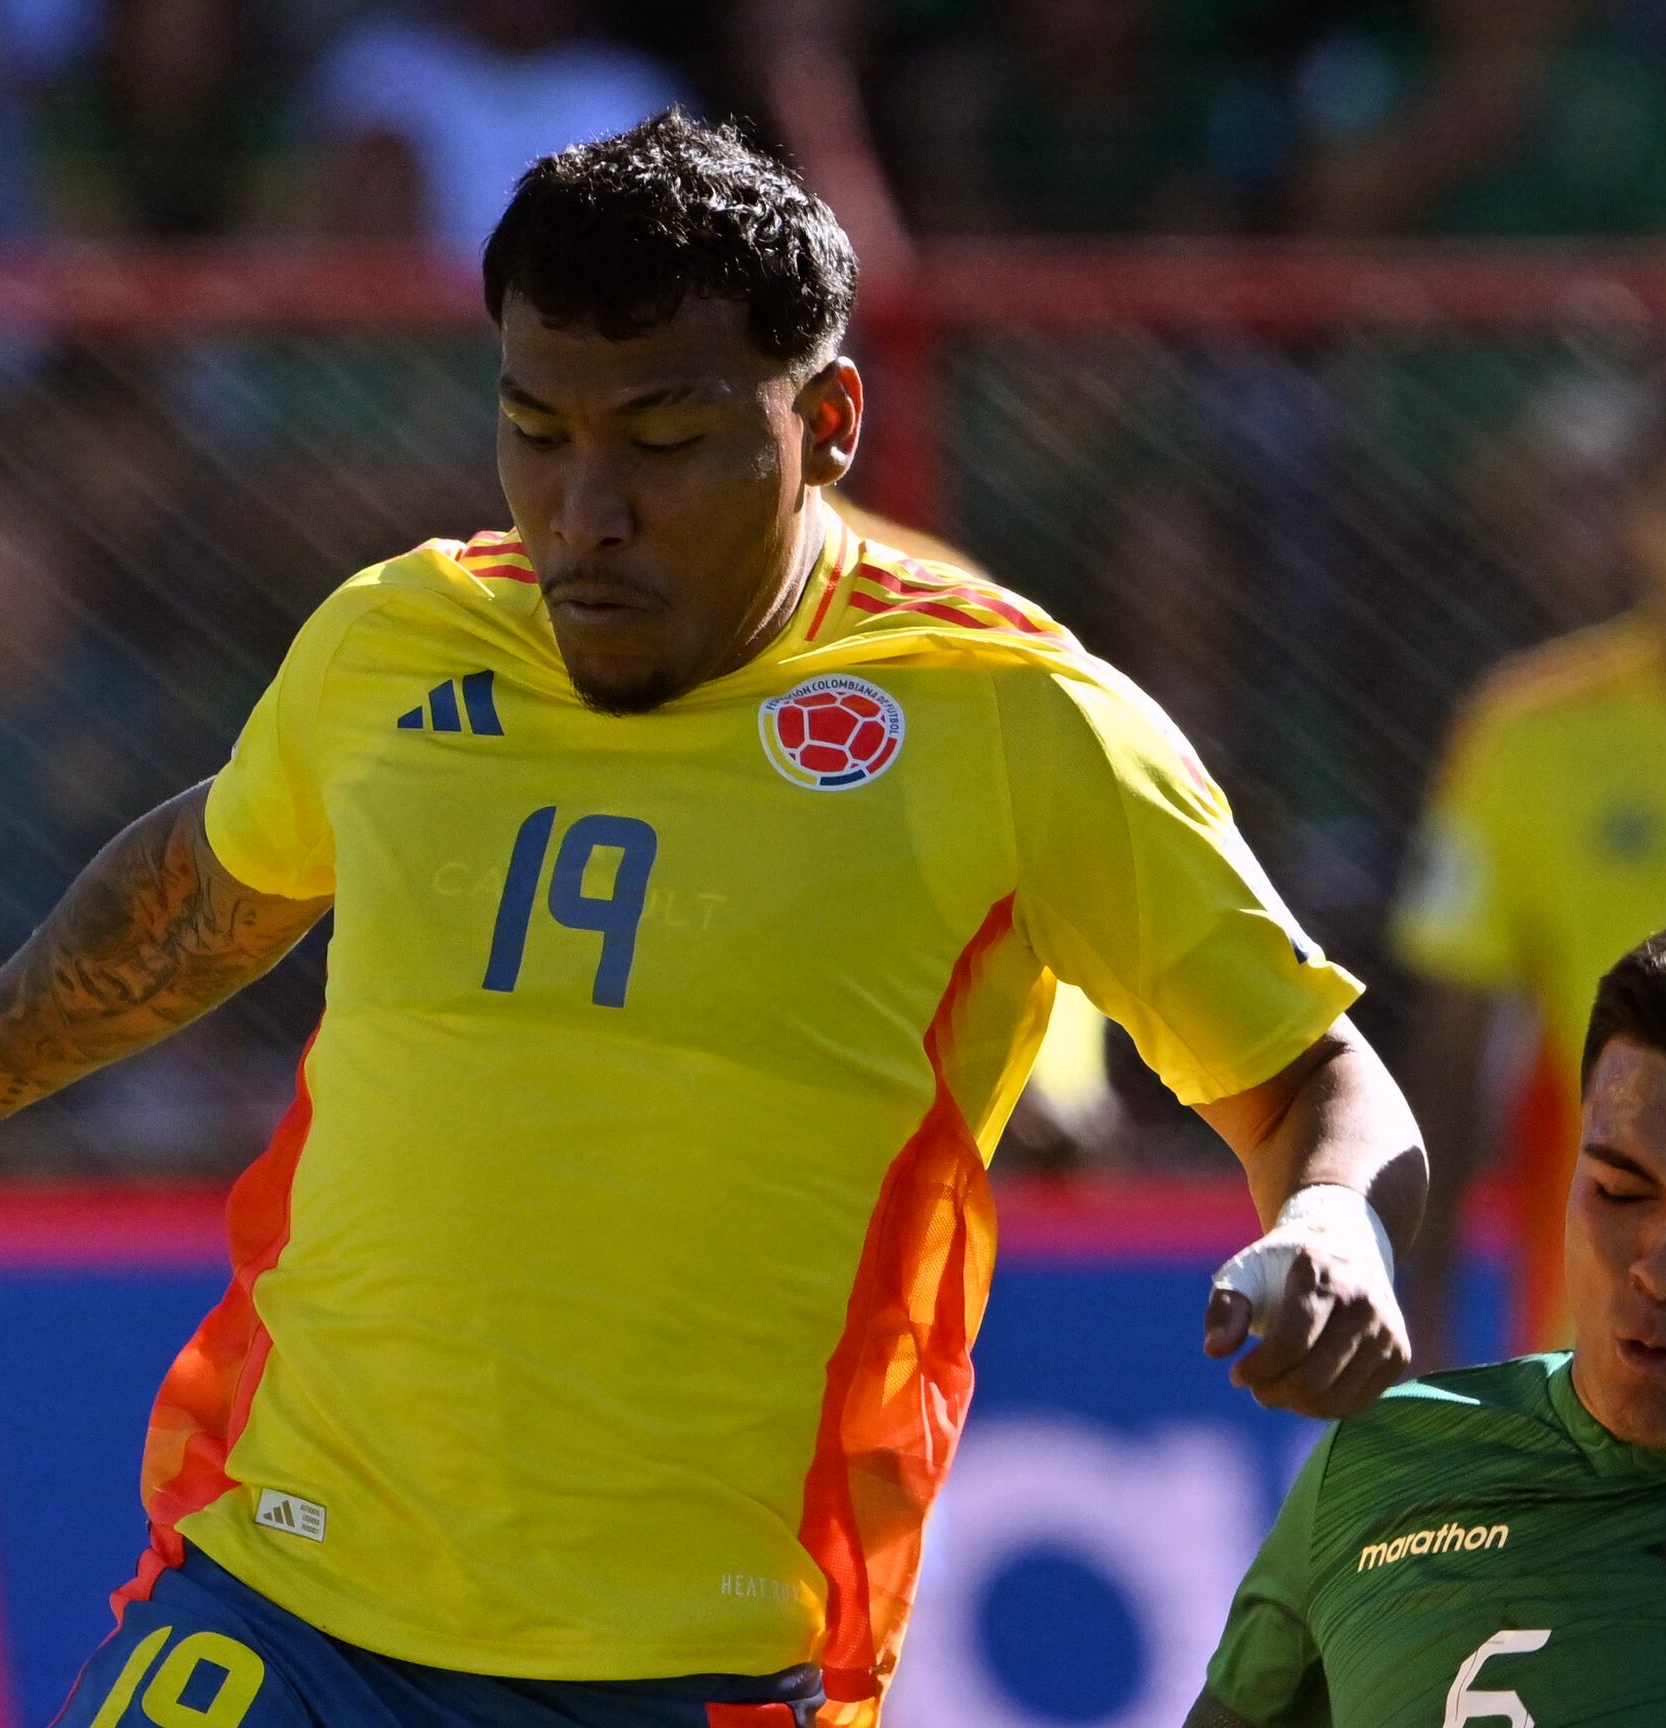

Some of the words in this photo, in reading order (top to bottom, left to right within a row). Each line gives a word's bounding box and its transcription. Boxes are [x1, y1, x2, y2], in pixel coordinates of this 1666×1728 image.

[811, 679, 879, 700] COLOMBIANA
[481, 805, 657, 1009] 19
[1357, 1521, 1509, 1573] marathon
